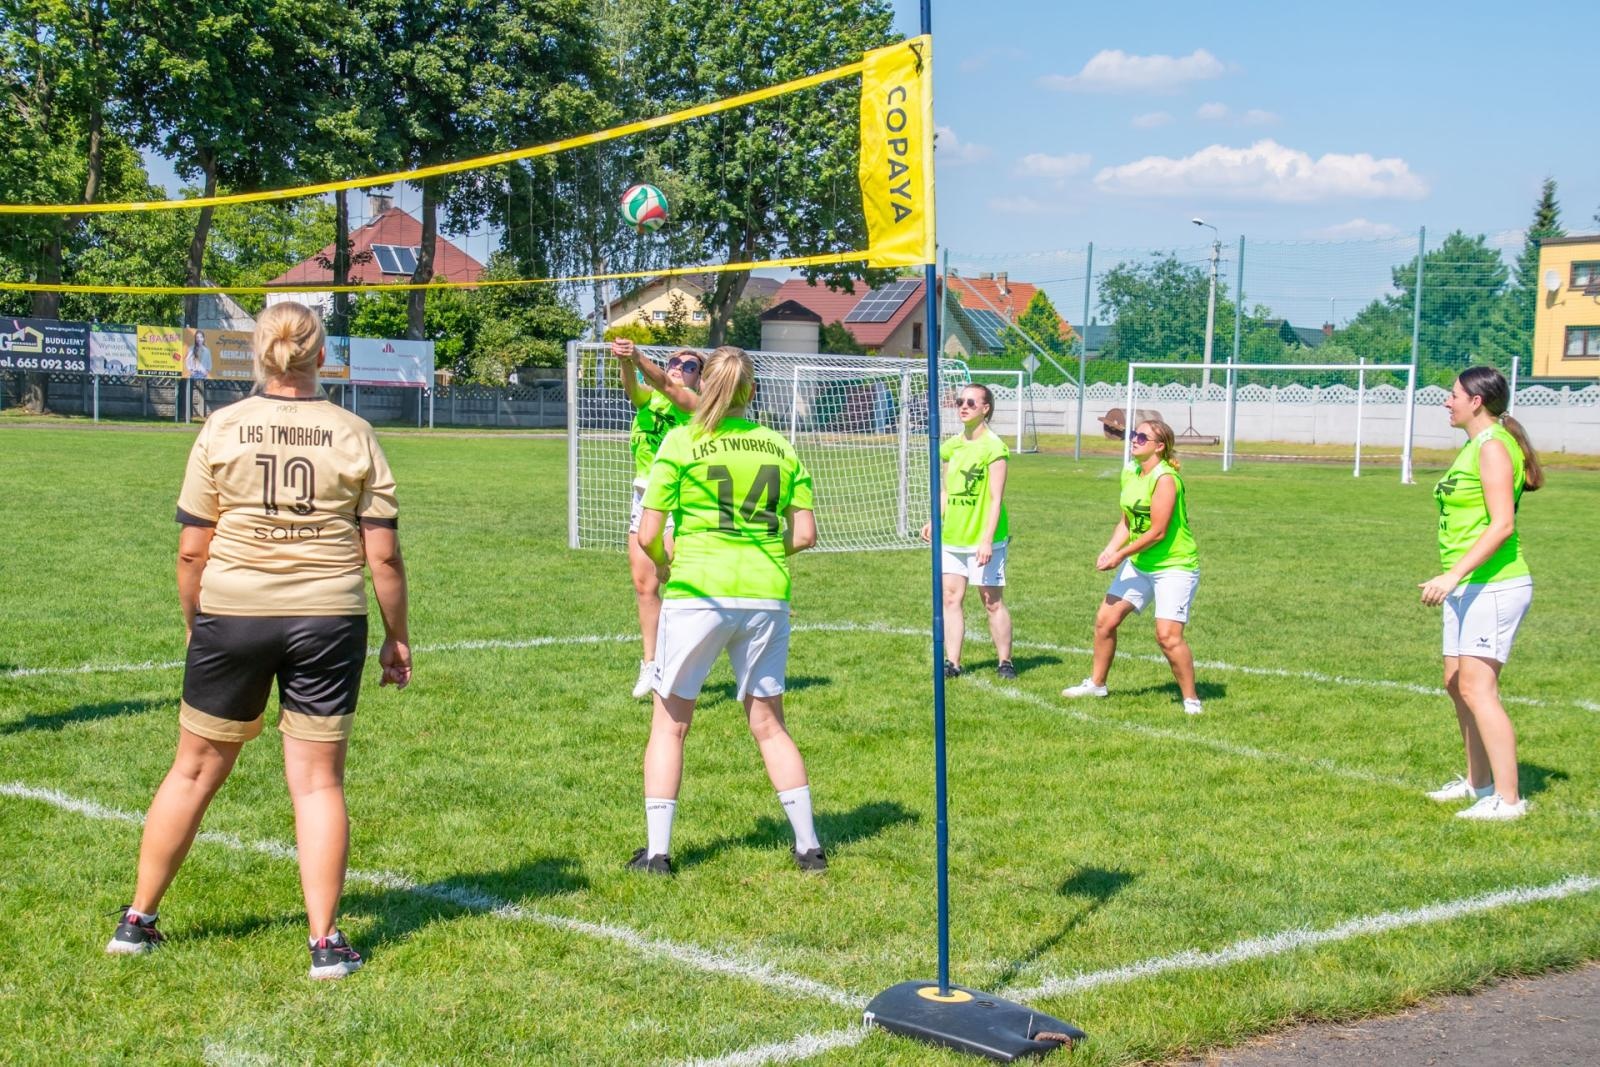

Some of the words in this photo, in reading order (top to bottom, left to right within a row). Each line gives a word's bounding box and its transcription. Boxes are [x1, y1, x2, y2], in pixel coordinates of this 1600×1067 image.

[886, 85, 912, 224] COPAYA
[45, 336, 86, 346] BUDUJEMY
[45, 346, 57, 354] OD
[79, 348, 85, 356] Z
[0, 356, 15, 368] el.
[16, 358, 39, 369] 665
[40, 359, 63, 370] 092
[64, 360, 86, 371] 363
[239, 425, 263, 444] LKS
[271, 425, 333, 447] TWORKÓW
[692, 440, 718, 460] LKS
[720, 438, 786, 460] TWORKÓW
[255, 453, 317, 516] 13
[706, 464, 781, 537] 14
